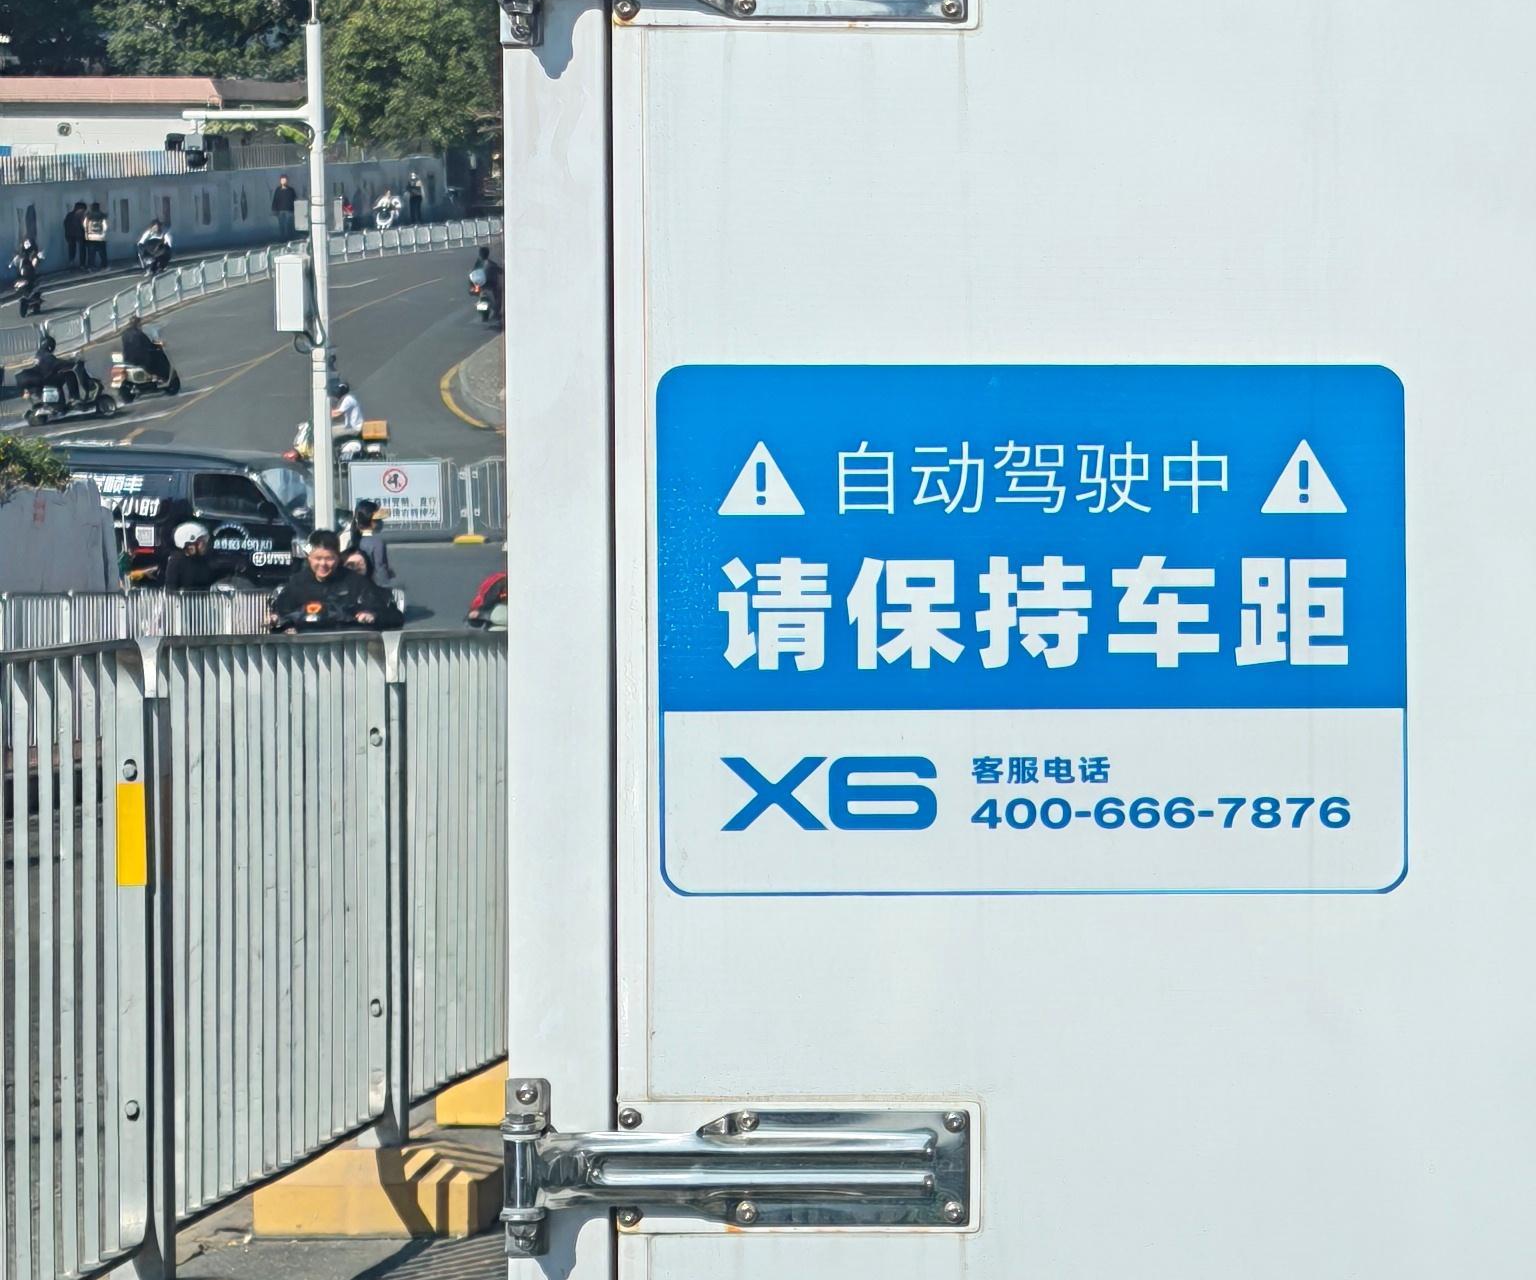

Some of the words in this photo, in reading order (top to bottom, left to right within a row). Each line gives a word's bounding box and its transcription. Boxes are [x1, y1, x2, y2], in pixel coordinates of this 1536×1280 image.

[837, 440, 1228, 514] 自动驾驶中
[718, 555, 1349, 672] 请保持车距
[720, 755, 938, 832] X6
[971, 755, 1111, 784] 客服电话
[970, 796, 1351, 830] 400-666-7876
